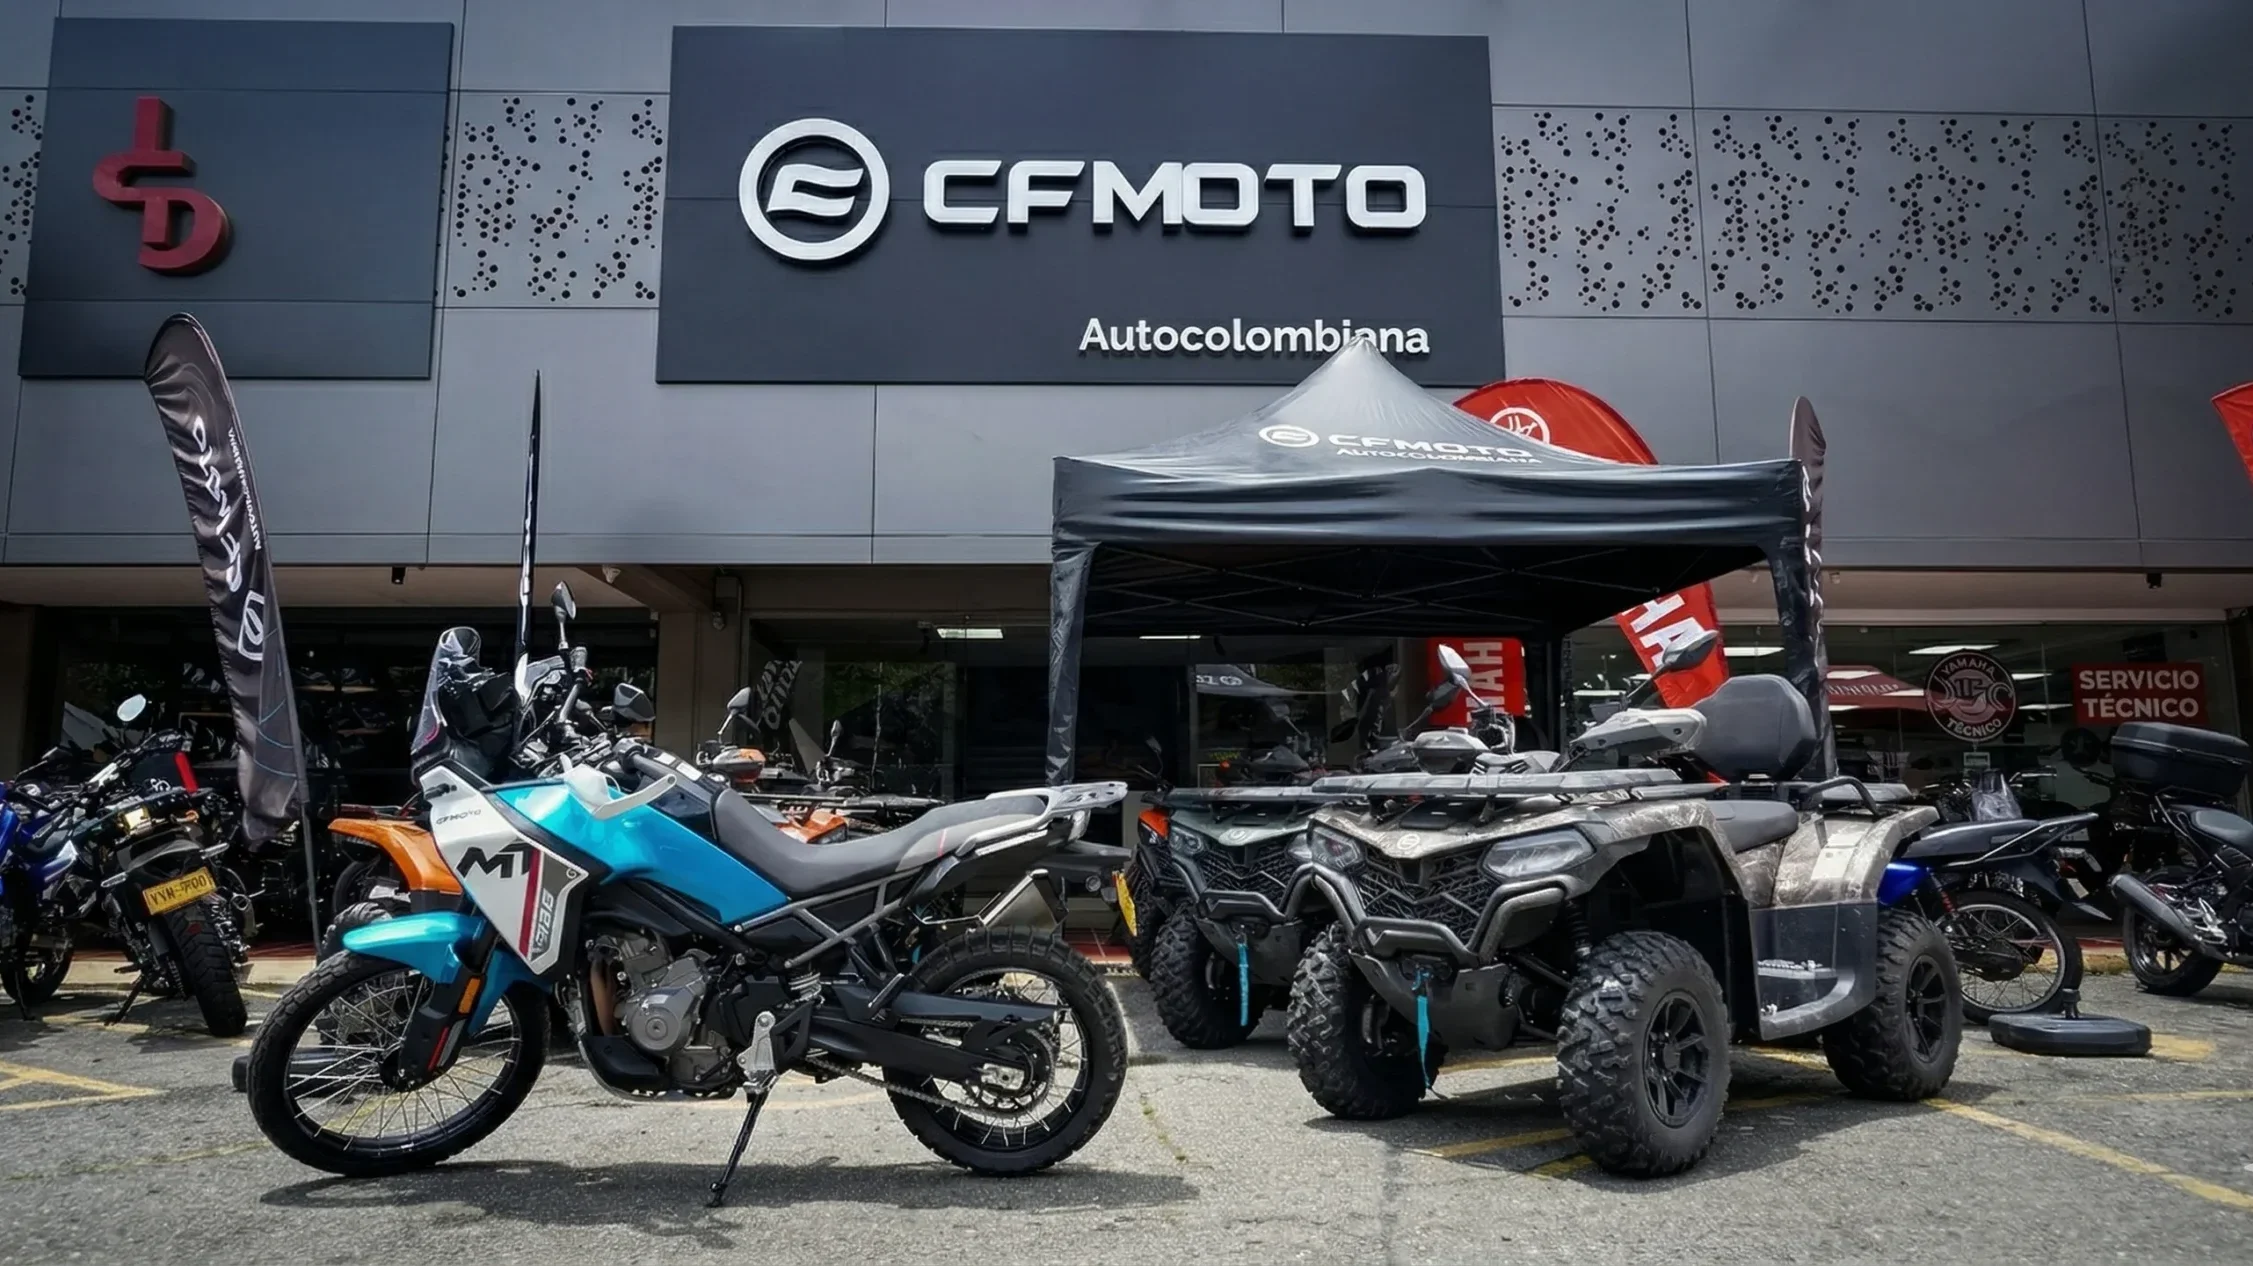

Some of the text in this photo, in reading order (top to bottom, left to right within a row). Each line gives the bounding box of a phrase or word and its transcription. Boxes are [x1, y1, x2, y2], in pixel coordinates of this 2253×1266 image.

[922, 159, 1428, 231] CFMOTO
[1328, 433, 1534, 458] CFMOTO
[1941, 658, 1996, 681] YAMAHA
[2079, 669, 2200, 690] SERVICIO
[2082, 692, 2200, 718] TÉCNICO
